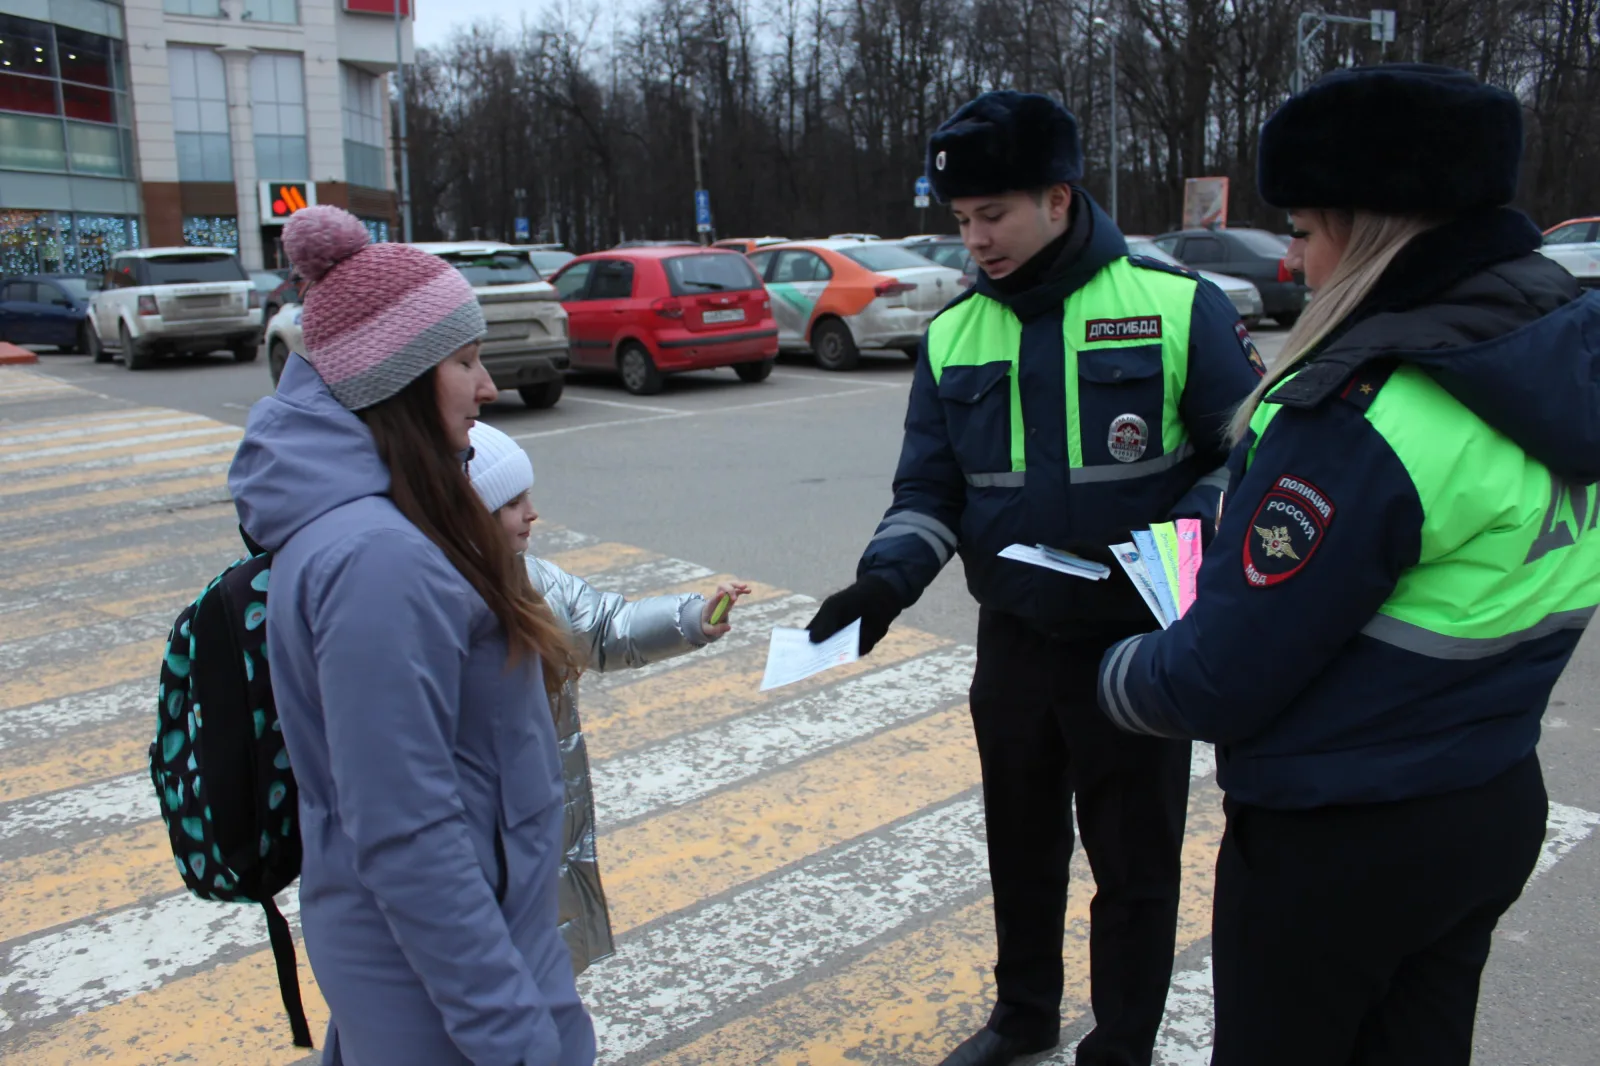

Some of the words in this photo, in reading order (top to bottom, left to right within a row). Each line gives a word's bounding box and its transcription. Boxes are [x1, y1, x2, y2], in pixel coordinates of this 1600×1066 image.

[1089, 322, 1115, 338] ДПС
[1116, 319, 1158, 335] ГИБДД
[1279, 477, 1331, 519] ПОЛИЦИЯ
[1266, 501, 1315, 541] РОССИЯ
[1245, 563, 1267, 586] МВД
